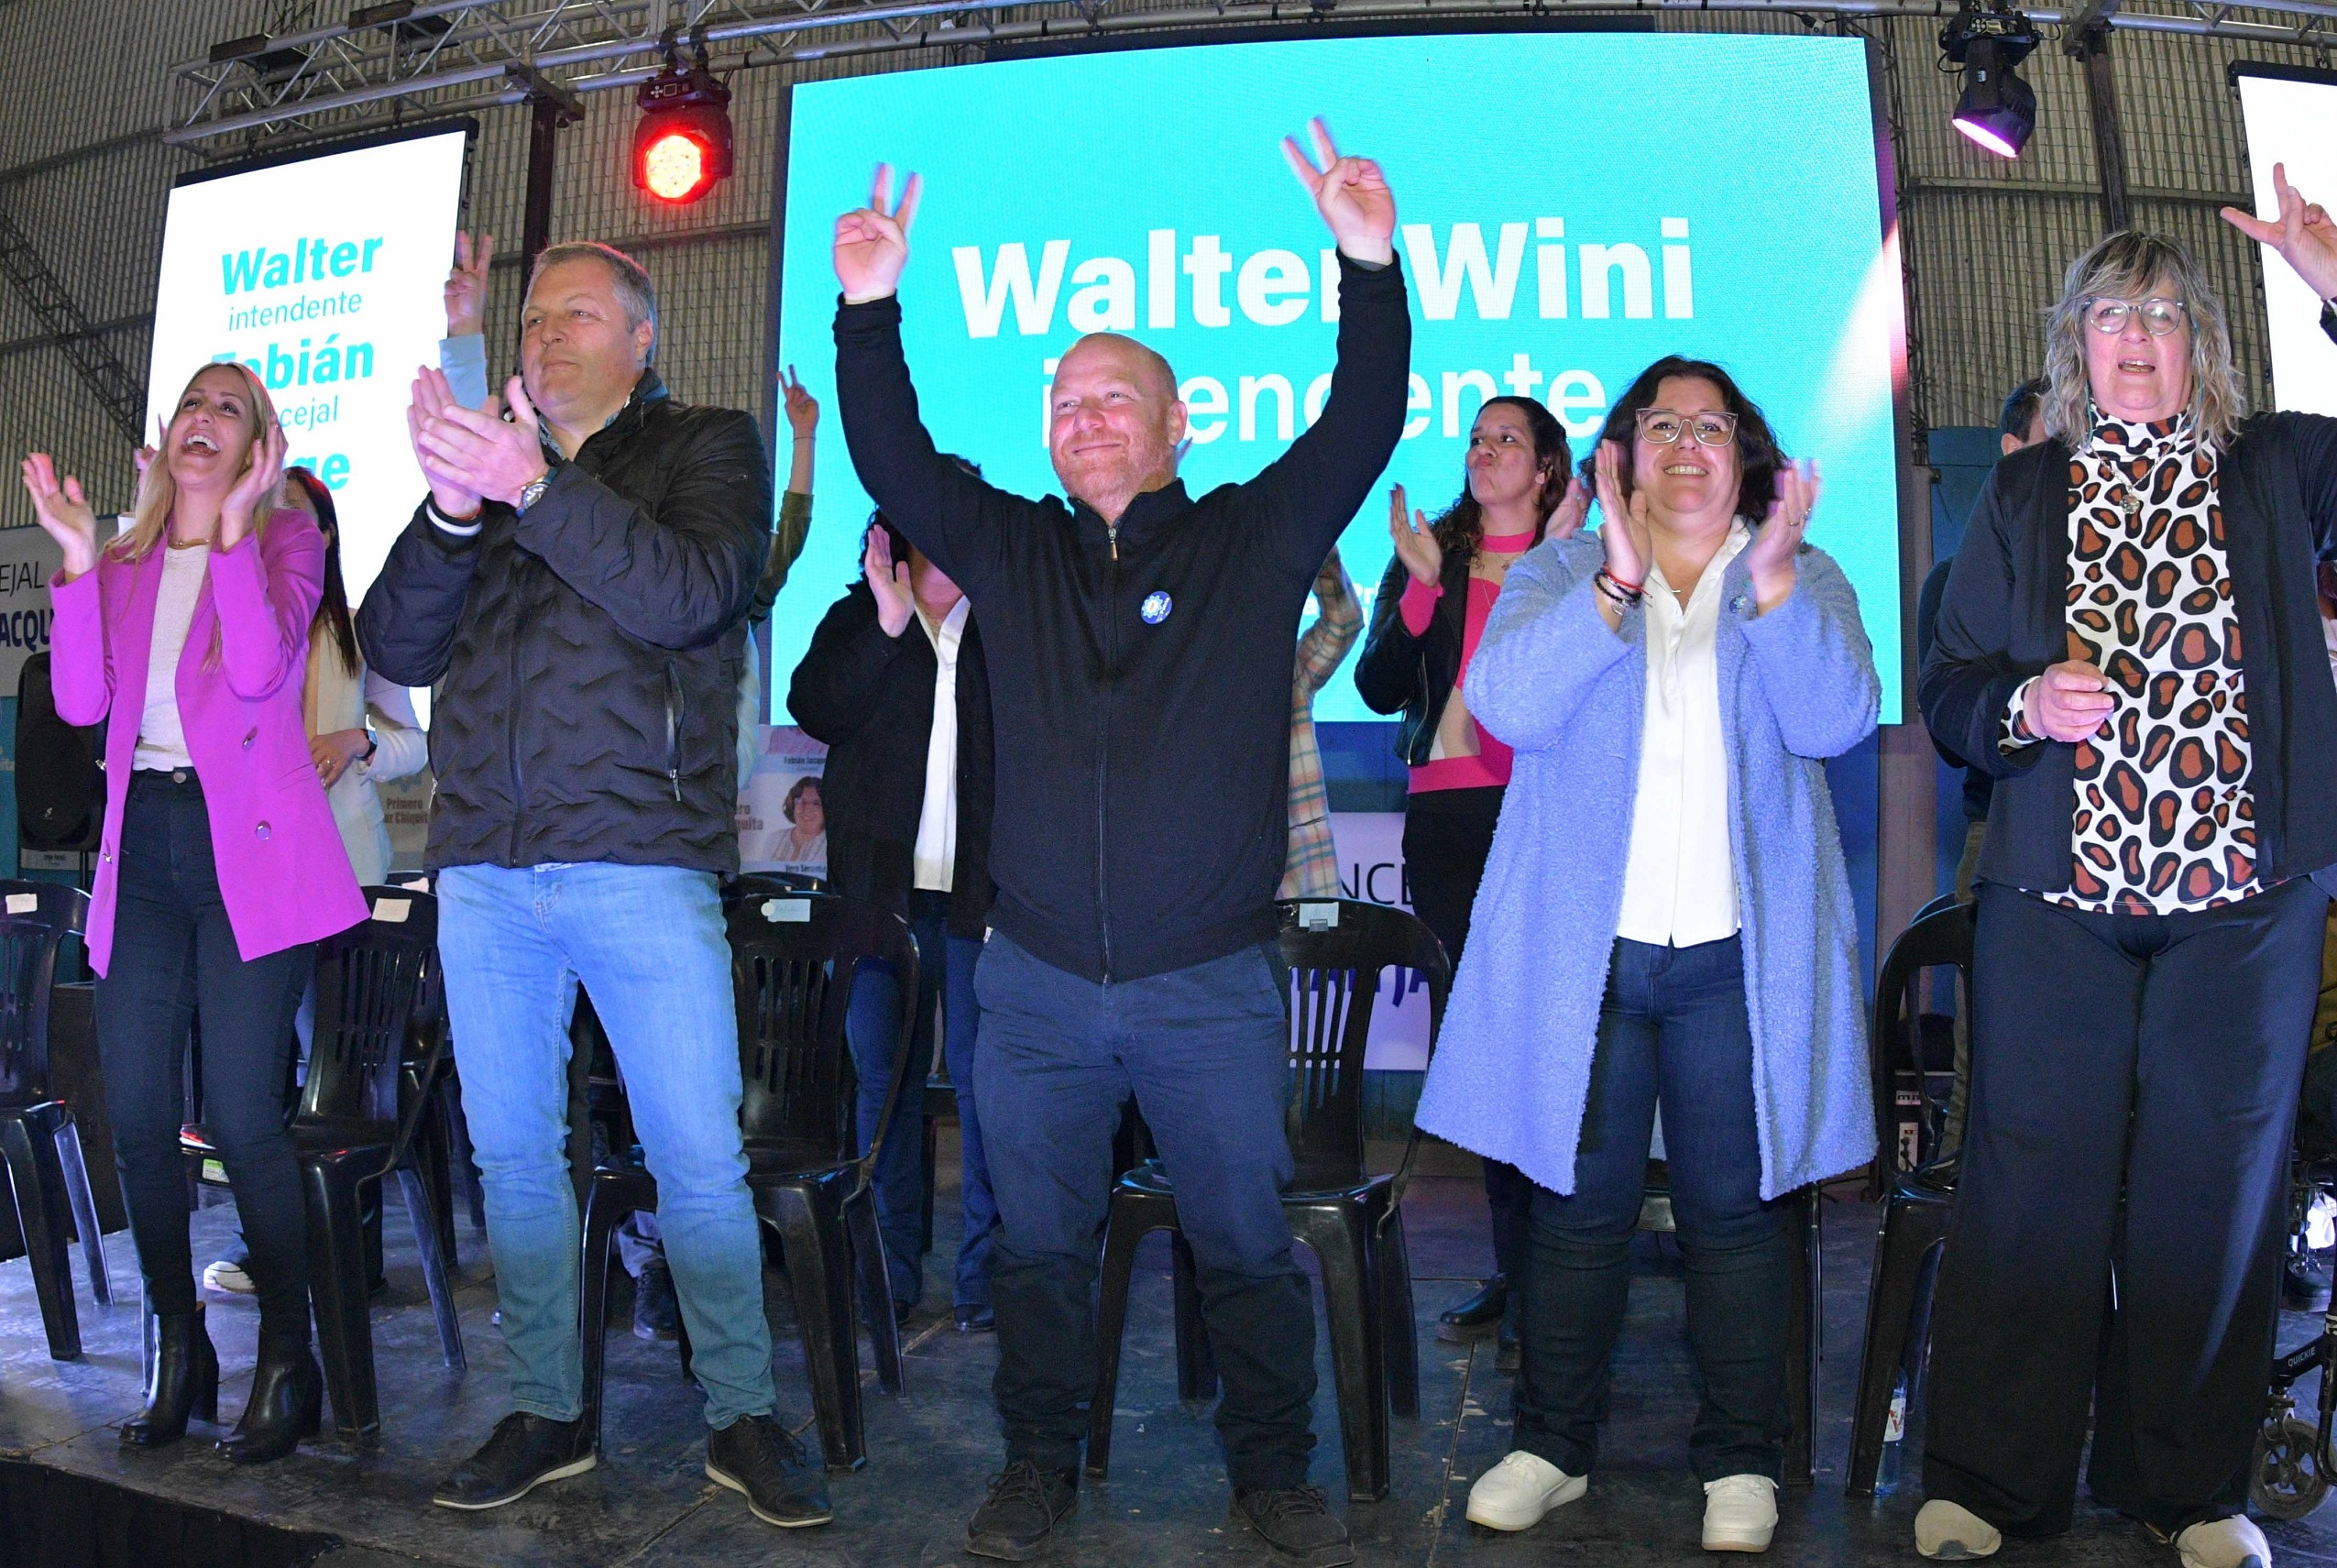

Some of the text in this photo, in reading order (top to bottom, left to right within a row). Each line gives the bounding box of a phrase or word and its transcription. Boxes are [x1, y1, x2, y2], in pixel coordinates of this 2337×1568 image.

[222, 236, 384, 295] Walter
[1400, 216, 1694, 321] Wini
[229, 291, 363, 332] intendente
[2288, 1346, 2316, 1367] QUICKIE
